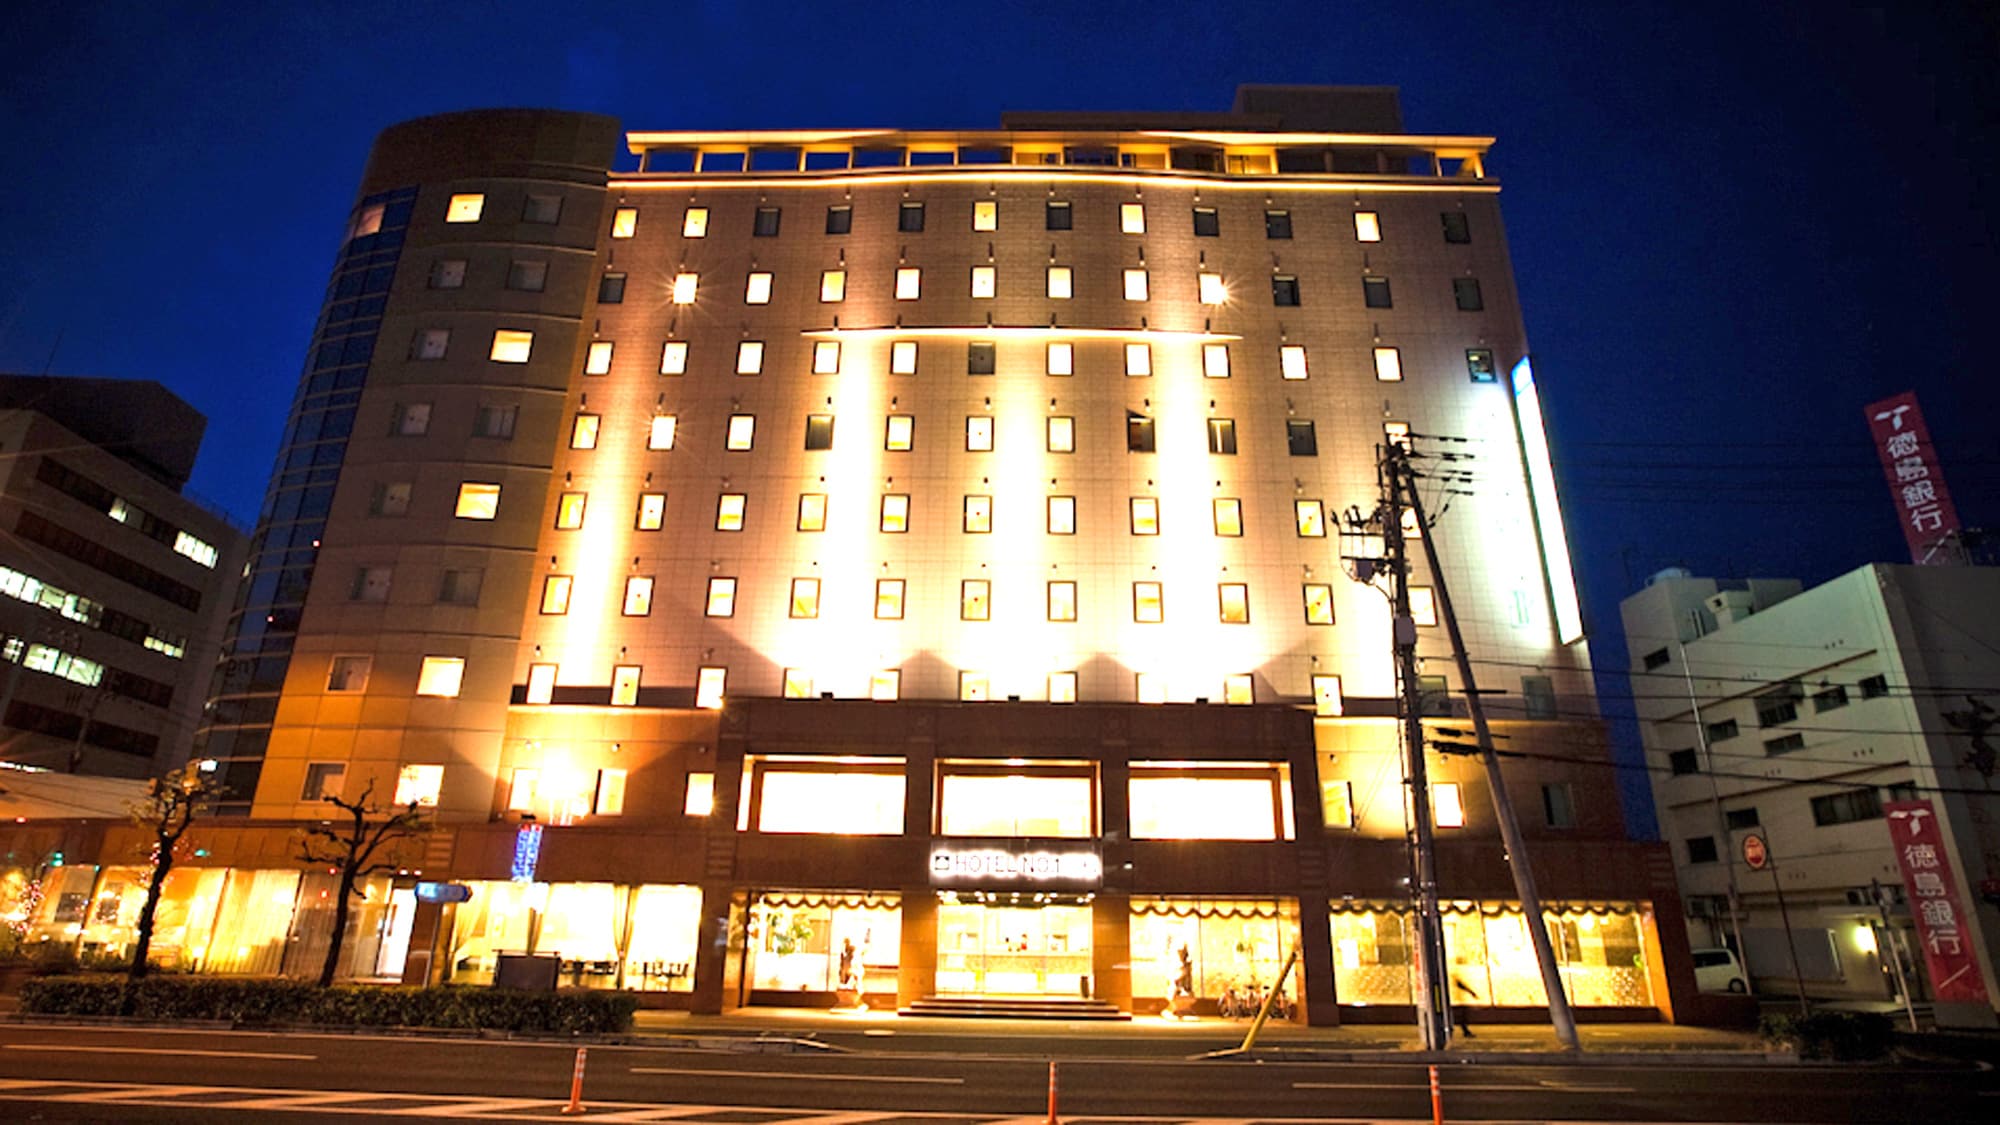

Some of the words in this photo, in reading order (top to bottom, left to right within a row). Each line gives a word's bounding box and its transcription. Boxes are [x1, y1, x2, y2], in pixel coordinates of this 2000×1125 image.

[1887, 431, 1942, 532] 徳島銀行
[955, 854, 1018, 873] HOTEL
[1904, 844, 1960, 955] 徳島銀行
